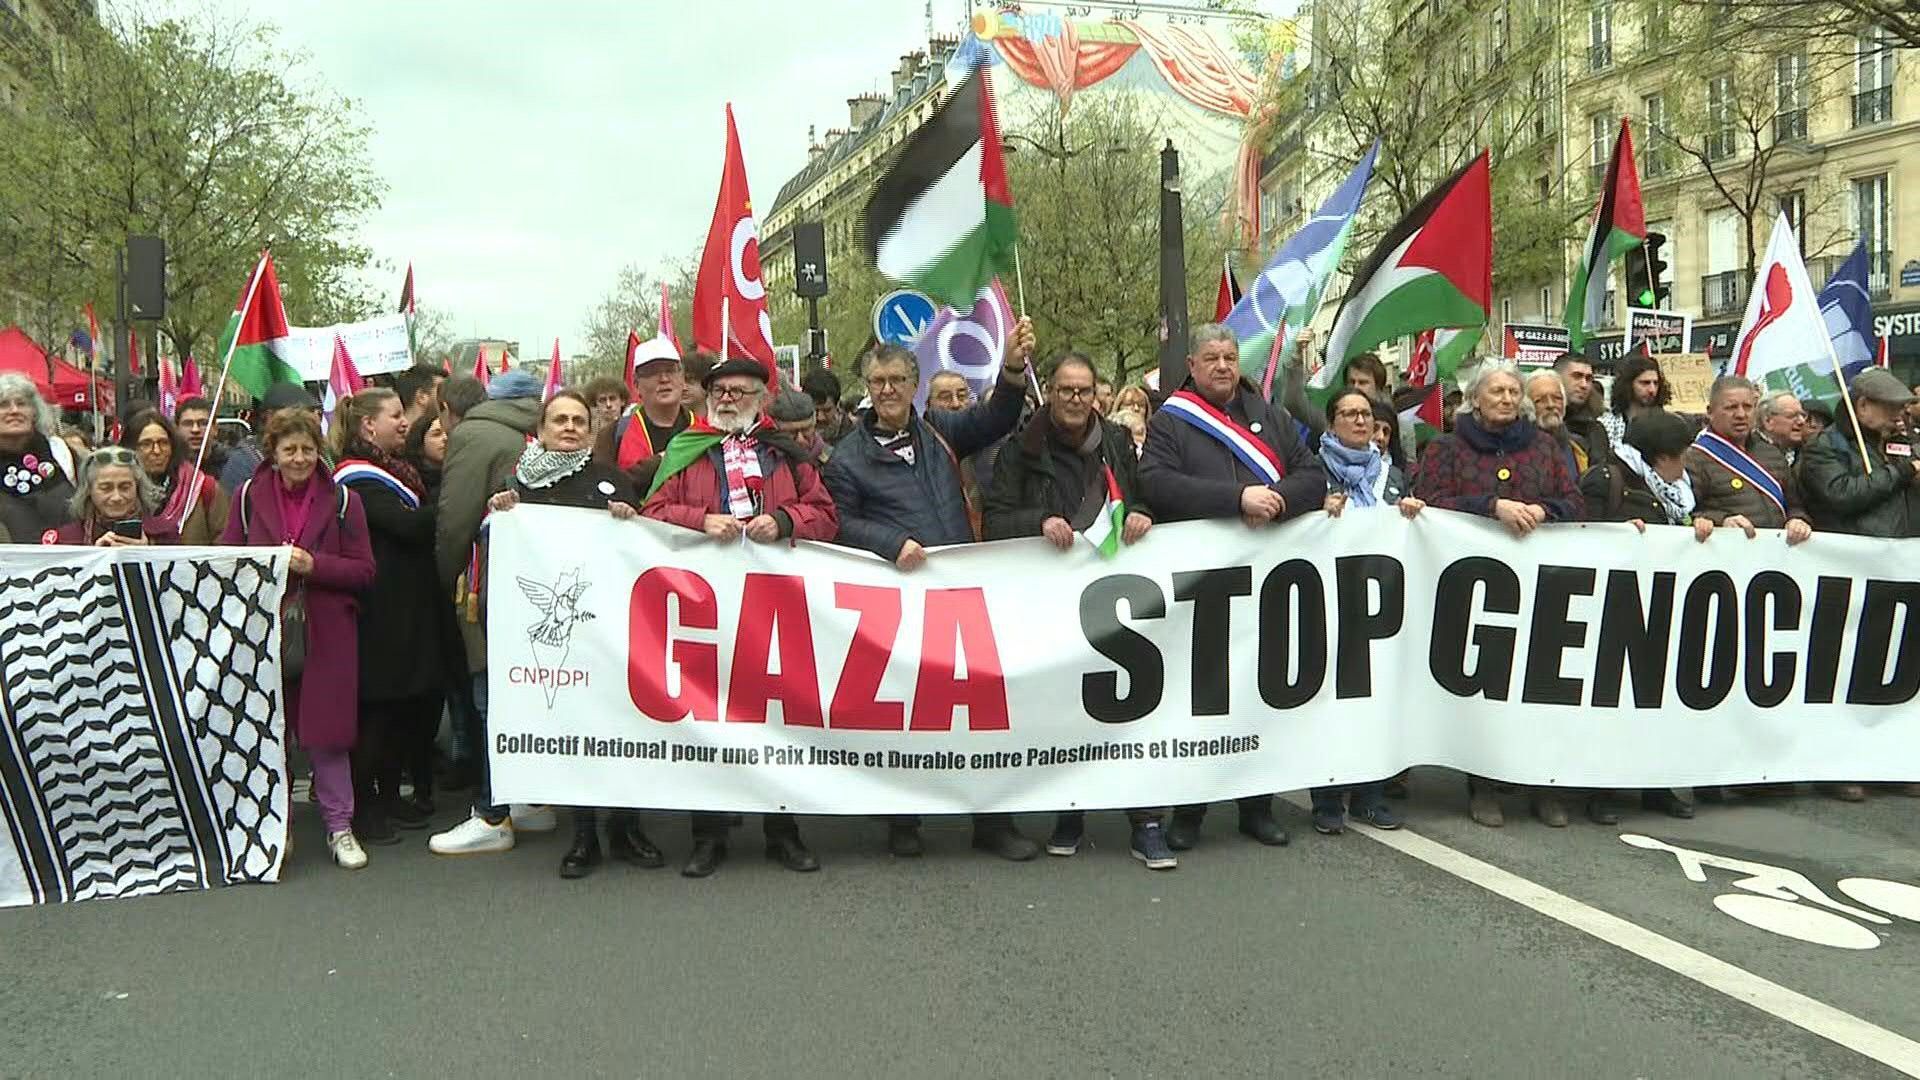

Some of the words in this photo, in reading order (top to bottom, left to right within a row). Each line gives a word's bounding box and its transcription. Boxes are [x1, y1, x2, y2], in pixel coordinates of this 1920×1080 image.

[1513, 330, 1525, 340] DE
[627, 566, 1010, 731] GAZA
[1079, 554, 1405, 724] STOP
[1429, 556, 1920, 711] GENOCID
[509, 666, 589, 688] CNPJDPI
[497, 734, 579, 755] Collectif
[584, 737, 666, 759] National
[672, 744, 717, 762] pour
[723, 748, 758, 764] une
[764, 746, 804, 765] Paix
[809, 746, 859, 766] Juste
[864, 751, 883, 768] et
[888, 751, 965, 770] Durable
[970, 752, 1022, 769] entre
[1027, 742, 1144, 766] Palestiniens
[1150, 741, 1167, 758] et
[1173, 735, 1259, 757] Israeliens
